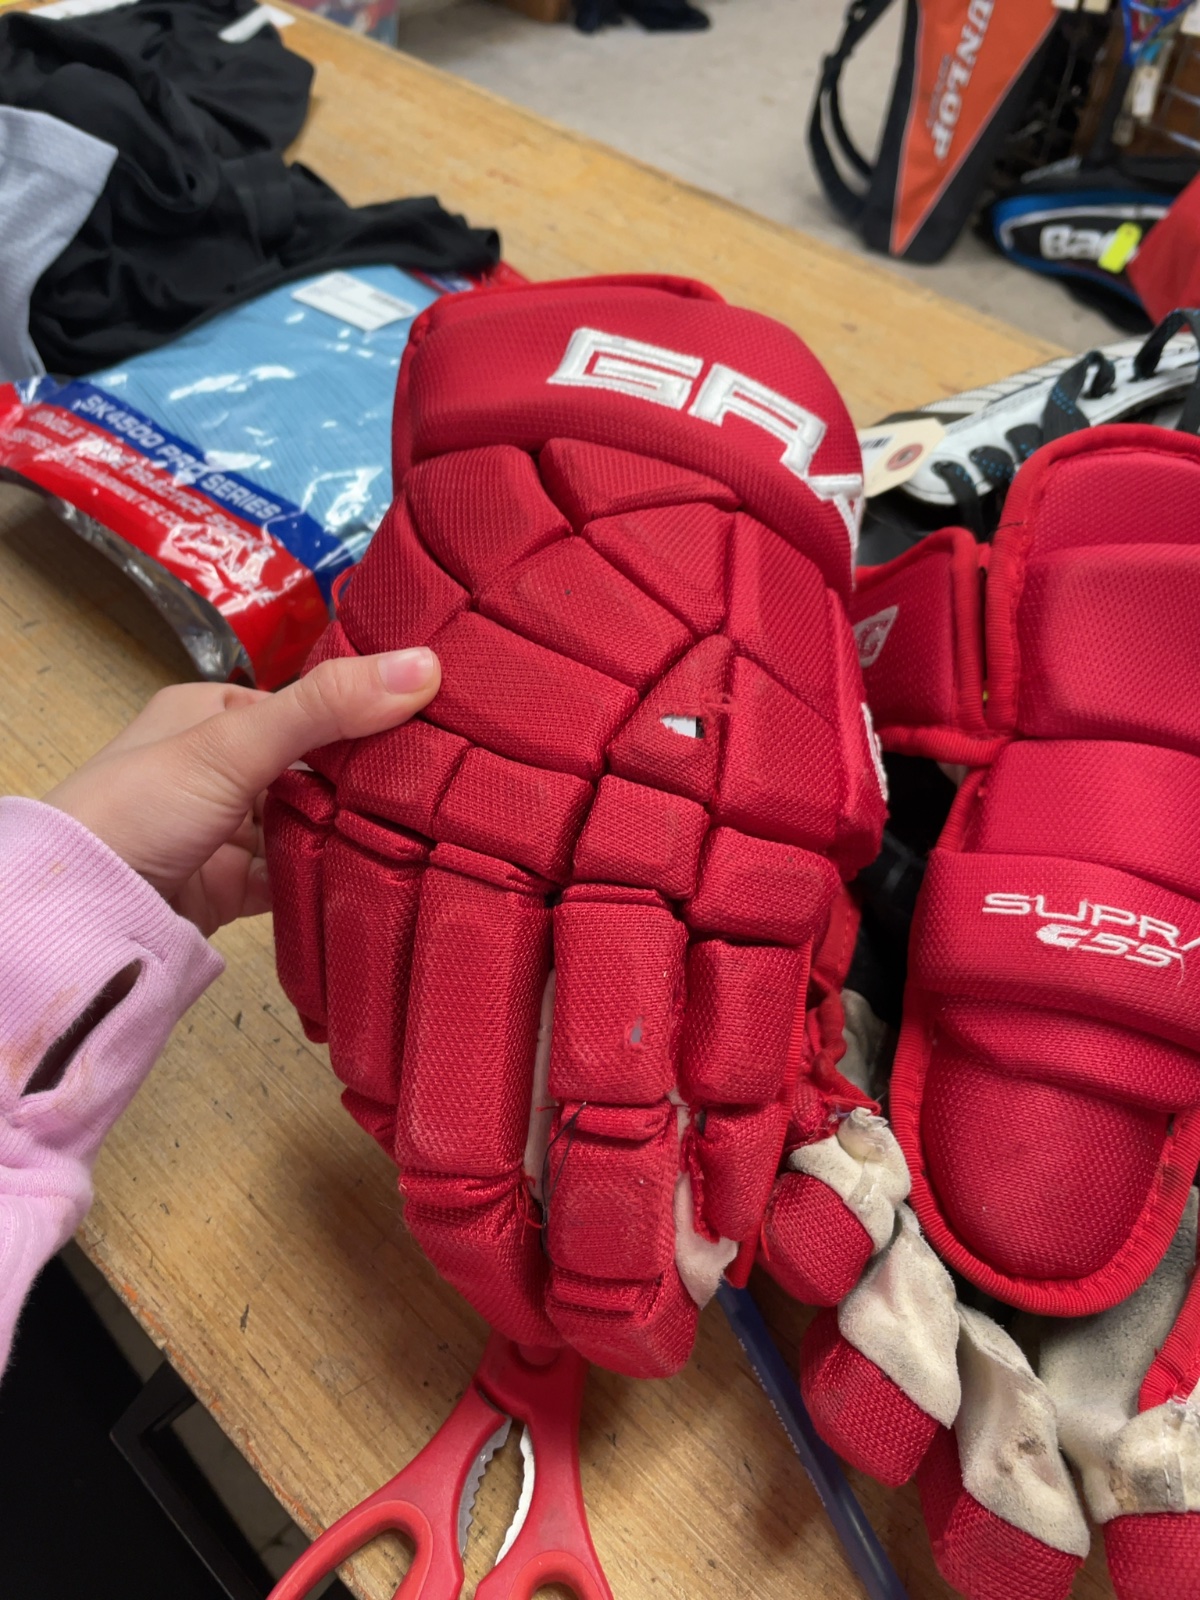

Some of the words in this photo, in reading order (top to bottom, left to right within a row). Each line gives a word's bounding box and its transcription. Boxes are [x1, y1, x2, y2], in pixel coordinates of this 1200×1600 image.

[80, 394, 165, 448] SK4500
[156, 444, 209, 479] PRO
[201, 473, 281, 519] SERIES
